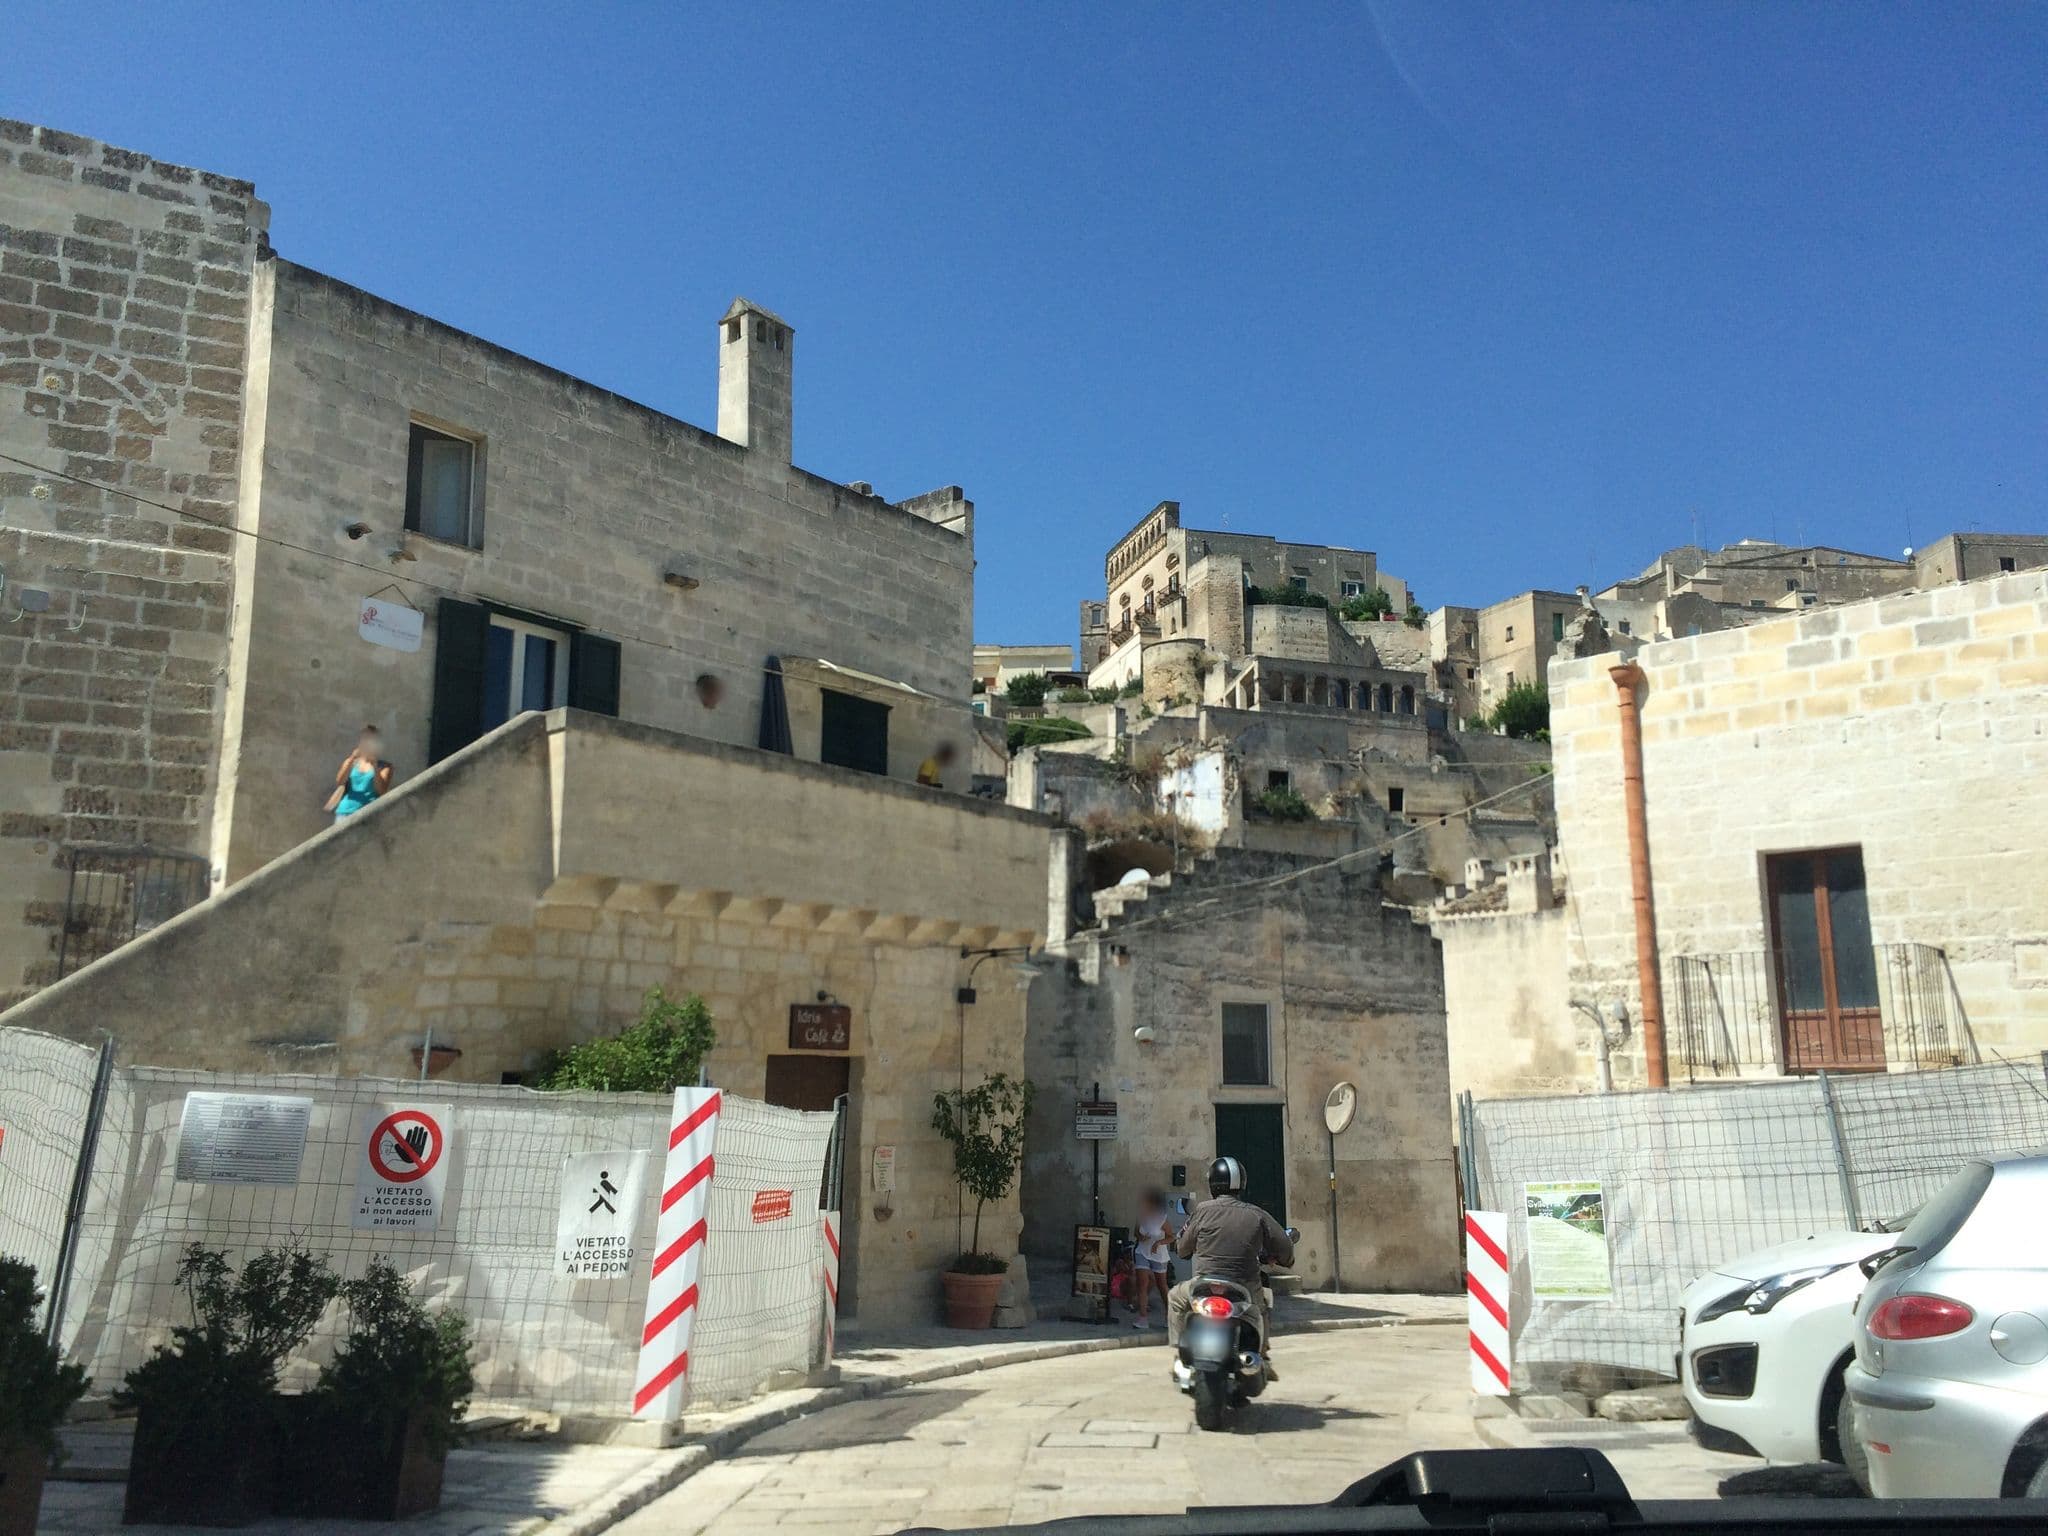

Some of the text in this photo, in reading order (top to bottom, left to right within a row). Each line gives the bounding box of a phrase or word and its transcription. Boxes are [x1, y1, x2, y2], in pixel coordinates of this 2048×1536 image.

[376, 1187, 423, 1196] VIETATO
[364, 1197, 432, 1206] L'ACCESSO
[396, 1208, 432, 1216] addetti
[386, 1217, 416, 1226] lavori
[576, 1236, 625, 1247] VIETATO
[563, 1248, 634, 1261] L'ACCESSO
[566, 1263, 579, 1274] AI
